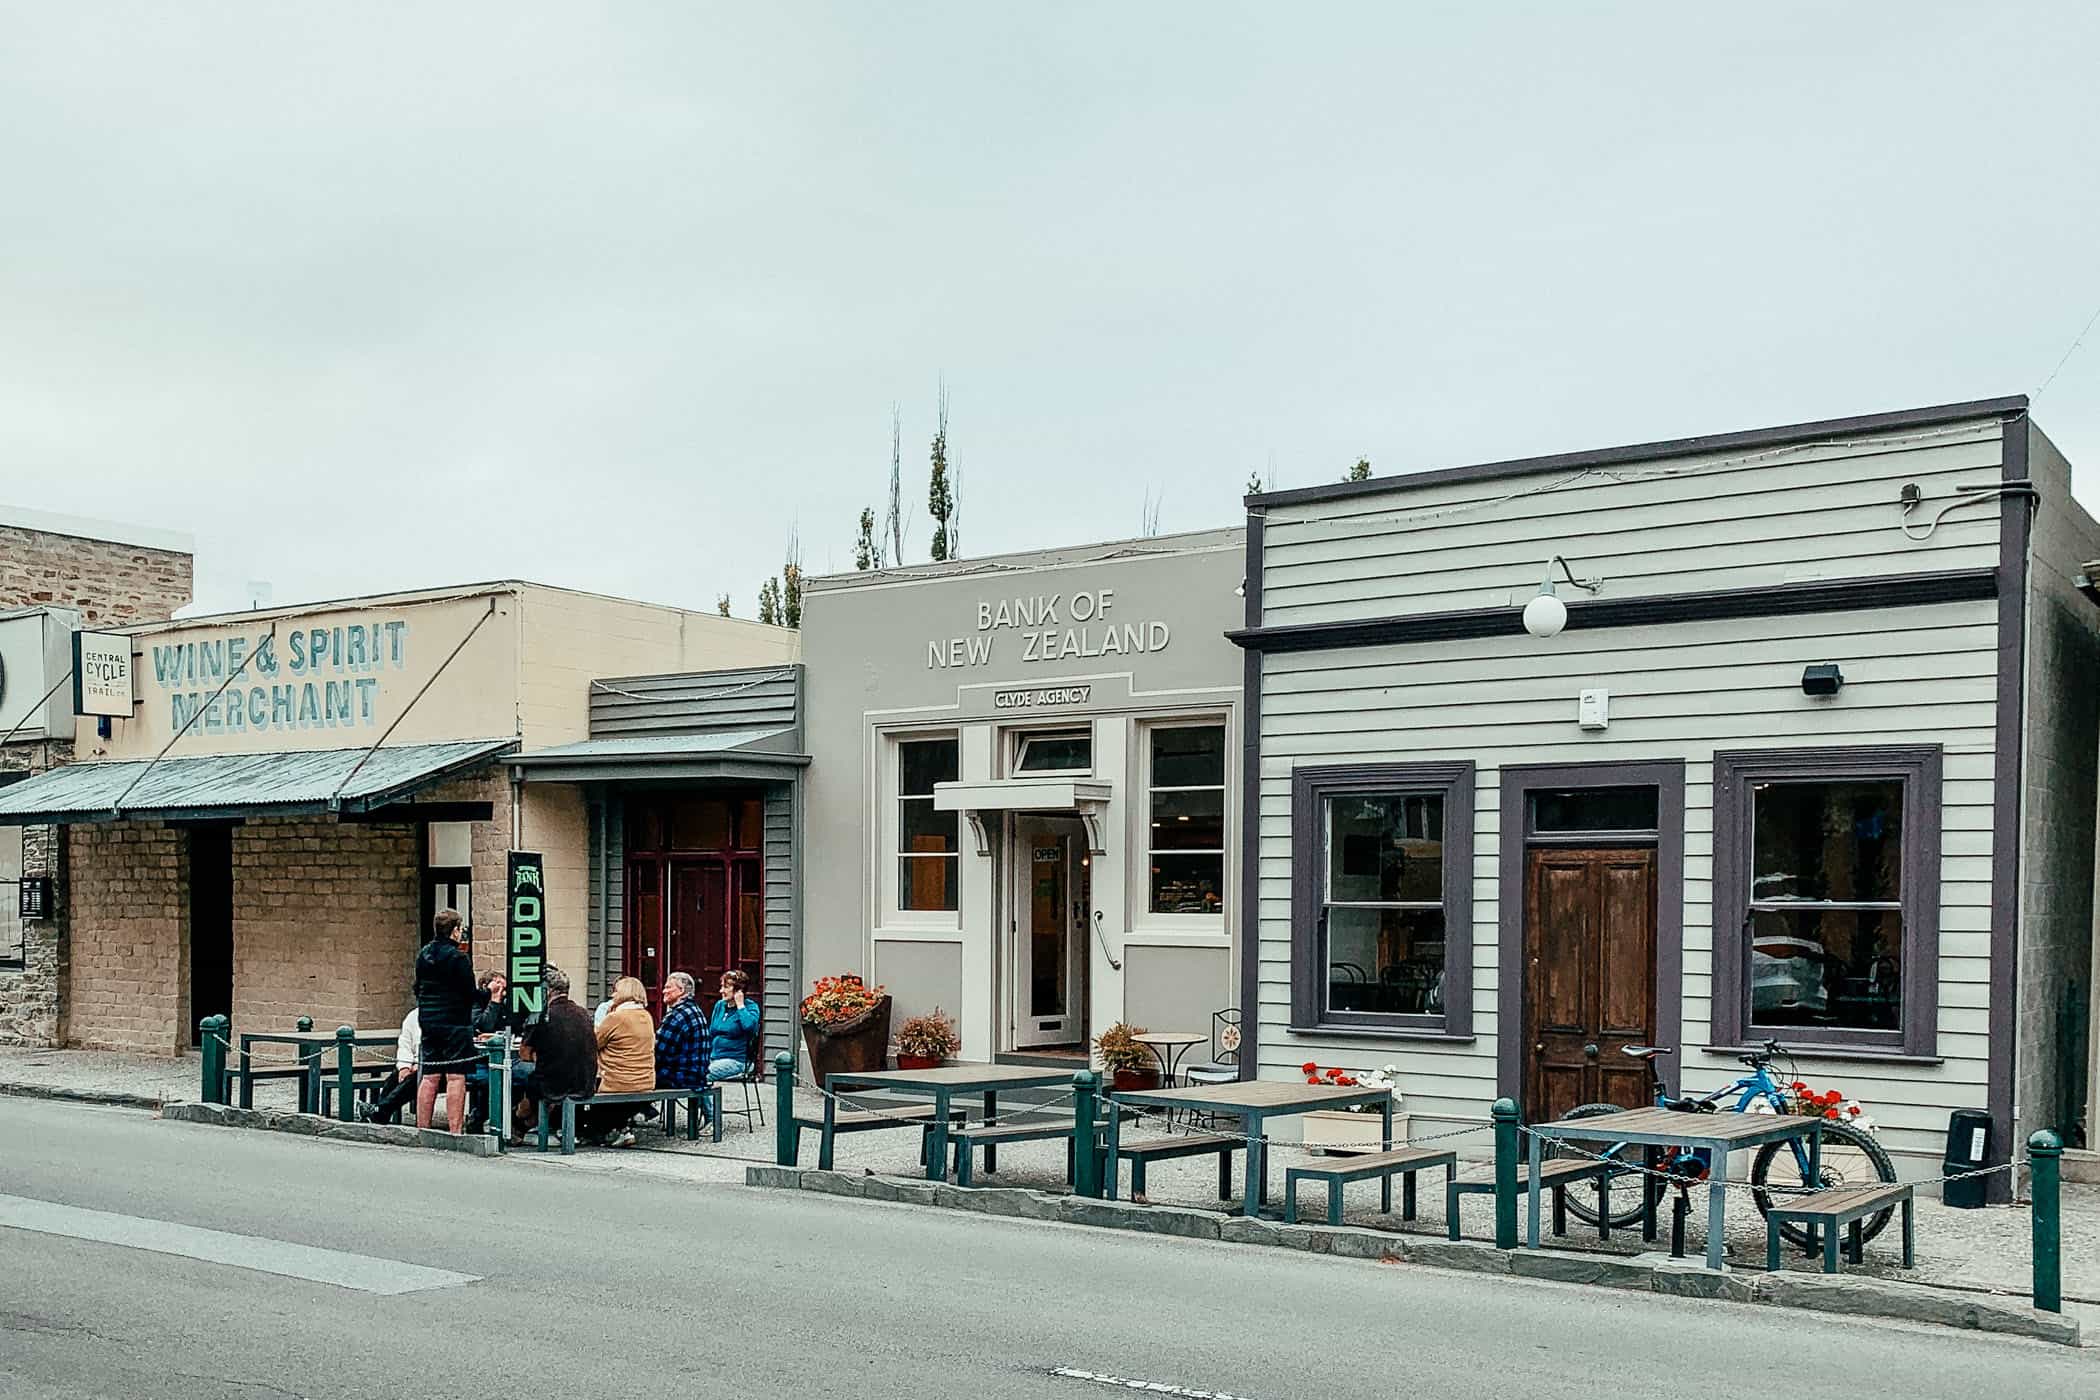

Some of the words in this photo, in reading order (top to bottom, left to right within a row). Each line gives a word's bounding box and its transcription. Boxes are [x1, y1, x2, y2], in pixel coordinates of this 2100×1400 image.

[977, 594, 1061, 631] BANK
[1070, 589, 1113, 622] OF
[86, 652, 126, 664] CENTRAL
[153, 637, 248, 687] WINE
[256, 634, 279, 678] &
[289, 621, 408, 676] SPIRIT
[928, 637, 993, 668] NEW
[1022, 621, 1169, 662] ZEALAND
[86, 662, 126, 681] CYCLE
[88, 687, 115, 697] TRAIL
[172, 678, 379, 737] MERCHANT
[995, 692, 1032, 708] CLYDE
[1037, 687, 1090, 705] AGENCY
[1034, 848, 1059, 860] OPEN
[512, 896, 544, 1013] OPEN
